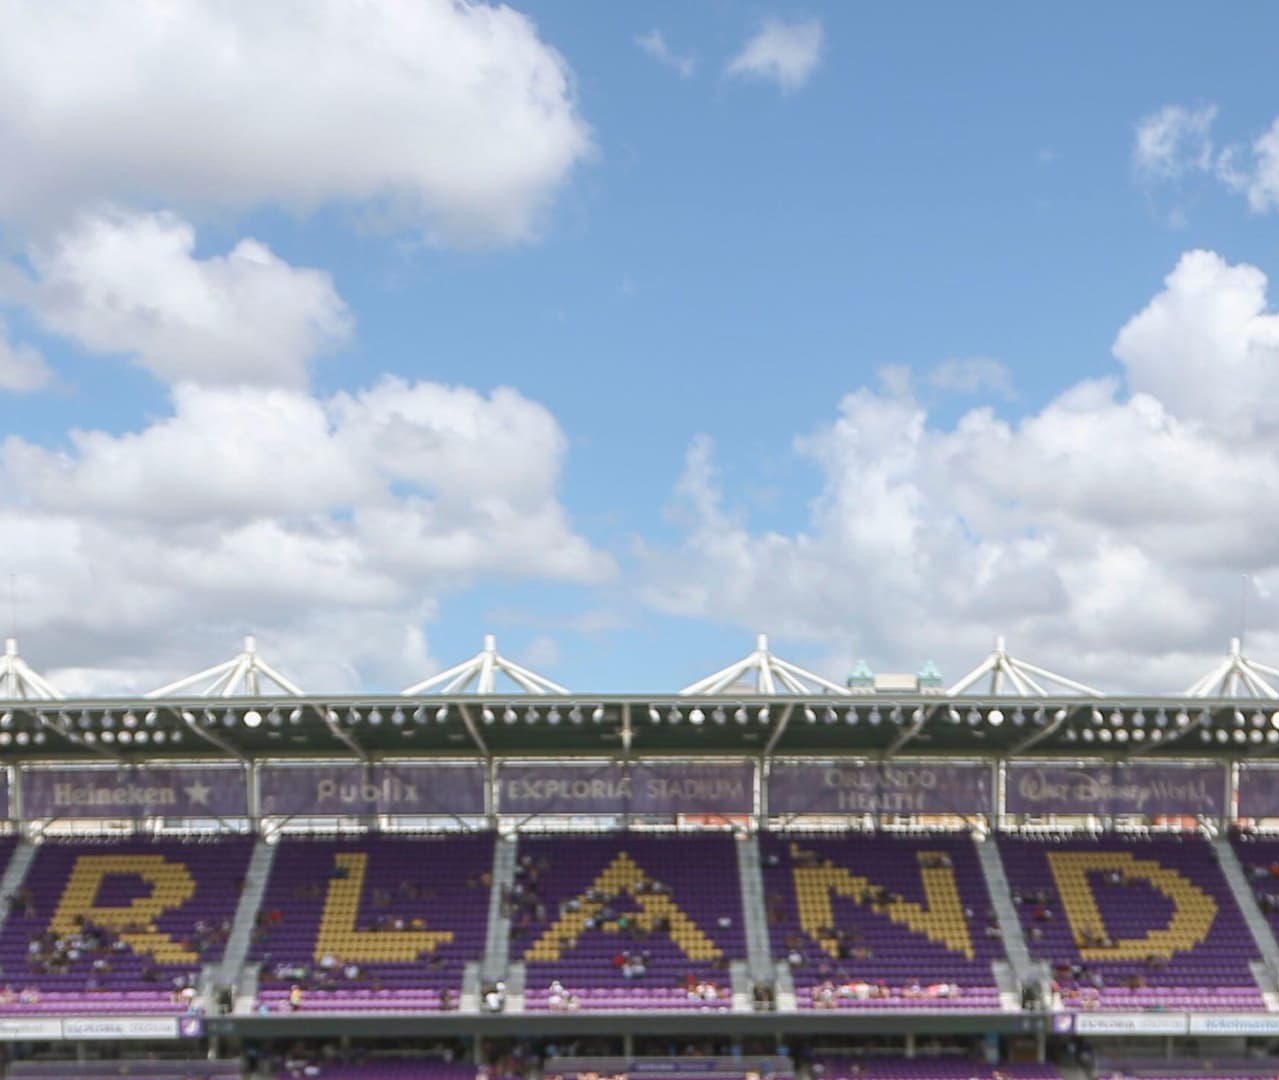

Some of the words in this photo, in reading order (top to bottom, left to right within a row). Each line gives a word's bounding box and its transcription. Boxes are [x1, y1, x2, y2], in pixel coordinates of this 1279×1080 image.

[53, 782, 174, 806] Heineken
[317, 775, 419, 802] Publix
[508, 777, 632, 799] EXPLORIA
[646, 777, 742, 799] STADIUM
